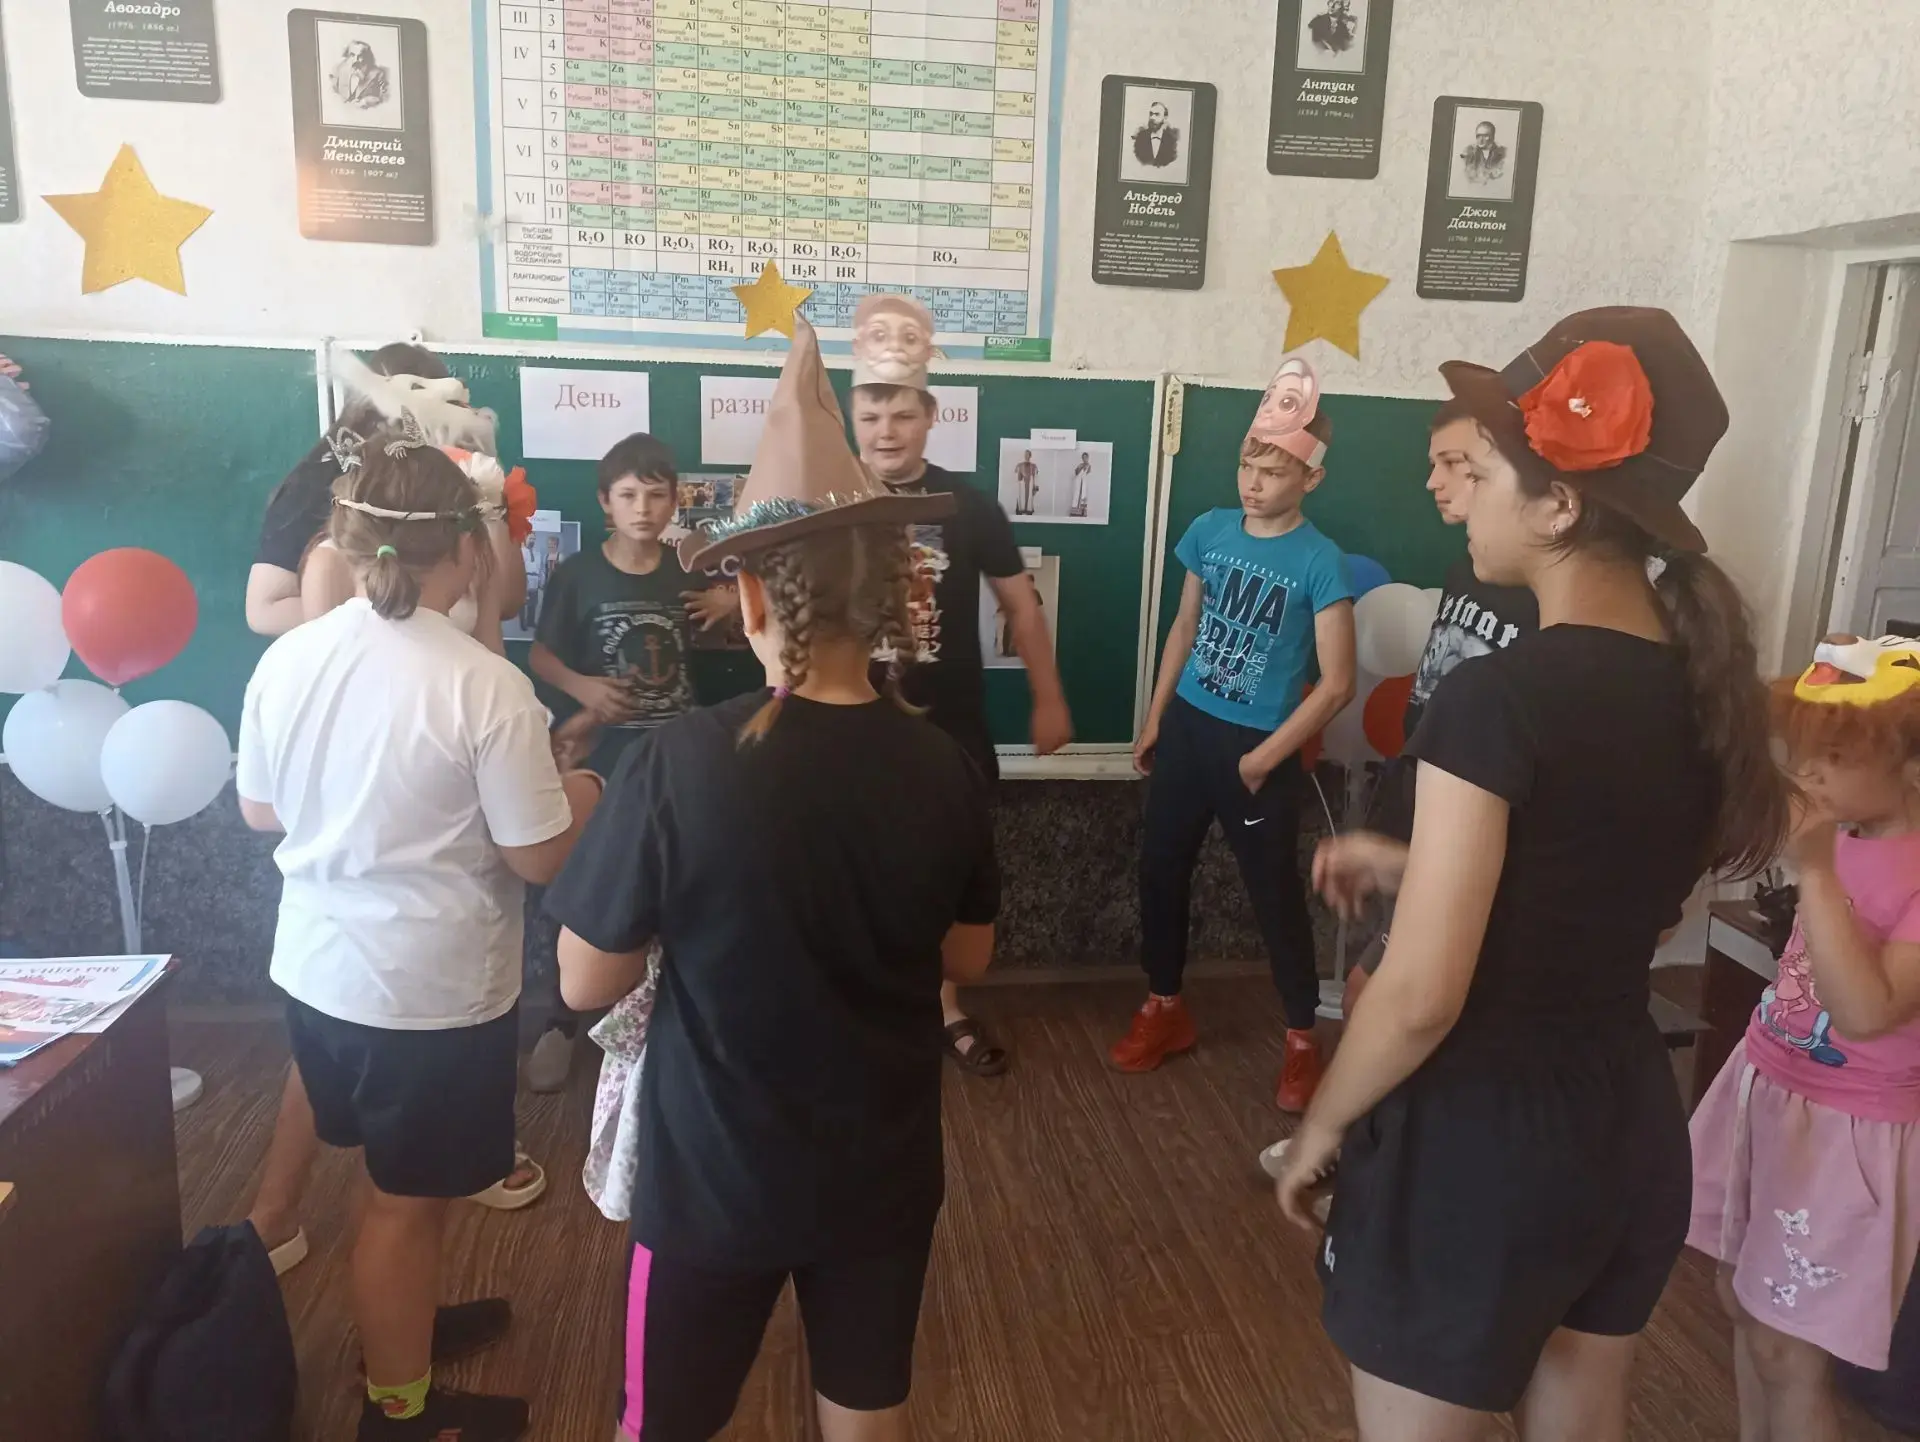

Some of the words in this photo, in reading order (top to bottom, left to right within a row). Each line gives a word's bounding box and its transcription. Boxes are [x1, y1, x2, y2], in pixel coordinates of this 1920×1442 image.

[104, 0, 181, 18] Авогадро
[732, 1, 740, 9] C
[775, 5, 783, 13] N
[818, 8, 827, 17] O
[863, 12, 869, 20] F
[513, 11, 528, 24] III
[548, 14, 556, 27] 3
[594, 14, 607, 23] Na
[636, 16, 652, 29] Mg
[685, 22, 696, 31] Al
[730, 25, 740, 34] Si
[1023, 24, 1037, 32] Ne
[777, 29, 783, 37] P
[820, 32, 826, 41] S
[599, 39, 607, 47] K
[858, 35, 869, 45] Cl
[548, 39, 556, 51] 4
[639, 41, 652, 51] Ca
[655, 43, 665, 52] Sc
[513, 46, 529, 59] IV
[700, 47, 710, 55] Ti
[743, 50, 751, 58] V
[1024, 47, 1036, 57] Ar
[786, 54, 798, 63] Cr
[829, 57, 845, 66] Mn
[566, 61, 579, 70] Cu
[611, 64, 624, 73] Zn
[872, 60, 882, 69] Fe
[914, 63, 927, 72] Co
[549, 63, 557, 76] 5
[956, 66, 967, 75] Ni
[683, 70, 696, 79] Ga
[726, 73, 740, 82] Ge
[771, 77, 783, 86] As
[815, 80, 826, 89] Se
[1301, 78, 1356, 93] Антуан
[594, 87, 608, 96] Rb
[858, 83, 868, 92] Br
[549, 87, 557, 100] 6
[656, 92, 664, 100] Y
[1296, 90, 1359, 106] Лавуазье
[700, 95, 710, 104] Zr
[743, 99, 758, 108] Nb
[1022, 94, 1034, 104] Kr
[517, 98, 528, 110] V
[786, 102, 802, 111] Mo
[829, 105, 840, 114] Tc
[871, 108, 884, 117] Ru
[550, 111, 558, 123] 7
[567, 109, 581, 120] Ag
[611, 112, 625, 121] Cd
[912, 110, 926, 119] Rh
[954, 113, 966, 122] Pd
[687, 118, 697, 127] In
[727, 121, 740, 130] Sn
[771, 125, 783, 133] Sb
[814, 127, 825, 136] Te
[597, 135, 609, 144] Cs
[863, 131, 867, 139] I
[323, 135, 403, 153] Дмитрий
[550, 136, 558, 148] 8
[641, 139, 653, 147] Ba
[700, 142, 713, 151] Hf
[1021, 140, 1032, 149] Xe
[516, 144, 532, 157] VI
[744, 146, 755, 155] Ta
[785, 149, 797, 157] W
[322, 149, 406, 166] Менделеев
[828, 151, 841, 160] Re
[870, 154, 883, 163] Os
[568, 158, 582, 166] Au
[912, 156, 920, 165] Ir
[953, 159, 962, 168] Pt
[551, 160, 559, 172] 9
[613, 160, 627, 172] Hg
[689, 166, 697, 175] Tl
[728, 169, 740, 177] Pb
[773, 172, 783, 180] Bi
[814, 174, 825, 183] Po
[856, 177, 867, 186] At
[550, 183, 563, 196] 10
[600, 183, 609, 192] Fr
[641, 186, 653, 195] Ra
[1018, 186, 1031, 195] Rn
[515, 191, 535, 205] VII
[701, 191, 711, 199] Rf
[743, 193, 758, 202] Db
[1123, 190, 1183, 205] Альфред
[786, 196, 798, 206] Sg
[828, 198, 840, 207] Bh
[870, 201, 882, 209] Hs
[569, 204, 582, 215] Rg
[911, 203, 923, 212] Mt
[952, 204, 963, 213] Ds
[1128, 202, 1176, 217] Нобель
[1459, 206, 1498, 218] Джон
[551, 207, 562, 219] 11
[612, 208, 626, 217] Cn
[683, 212, 697, 221] Nh
[731, 215, 740, 223] Fl
[768, 218, 782, 227] Mc
[813, 219, 825, 228] Lv
[855, 222, 866, 231] Ts
[1446, 217, 1507, 231] Дальтон
[624, 233, 646, 246] RO
[1015, 231, 1029, 241] Og
[571, 269, 584, 278] Ce
[607, 271, 617, 279] Pr
[641, 272, 655, 281] Nd
[836, 266, 856, 278] HR
[674, 275, 689, 283] Pm
[708, 277, 722, 286] Sm
[808, 281, 819, 290] Tb
[839, 283, 852, 293] Dy
[871, 285, 885, 293] Ho
[573, 292, 586, 301] Th
[936, 289, 949, 297] Tm
[966, 289, 978, 298] Yb
[997, 291, 1009, 299] Lu
[608, 294, 619, 302] Pa
[641, 295, 649, 304] U
[674, 298, 689, 307] Np
[708, 299, 720, 308] Pu
[934, 310, 949, 319] Md
[966, 311, 979, 320] No
[997, 312, 1007, 321] Lr
[555, 384, 621, 411] День
[710, 397, 771, 419] разн
